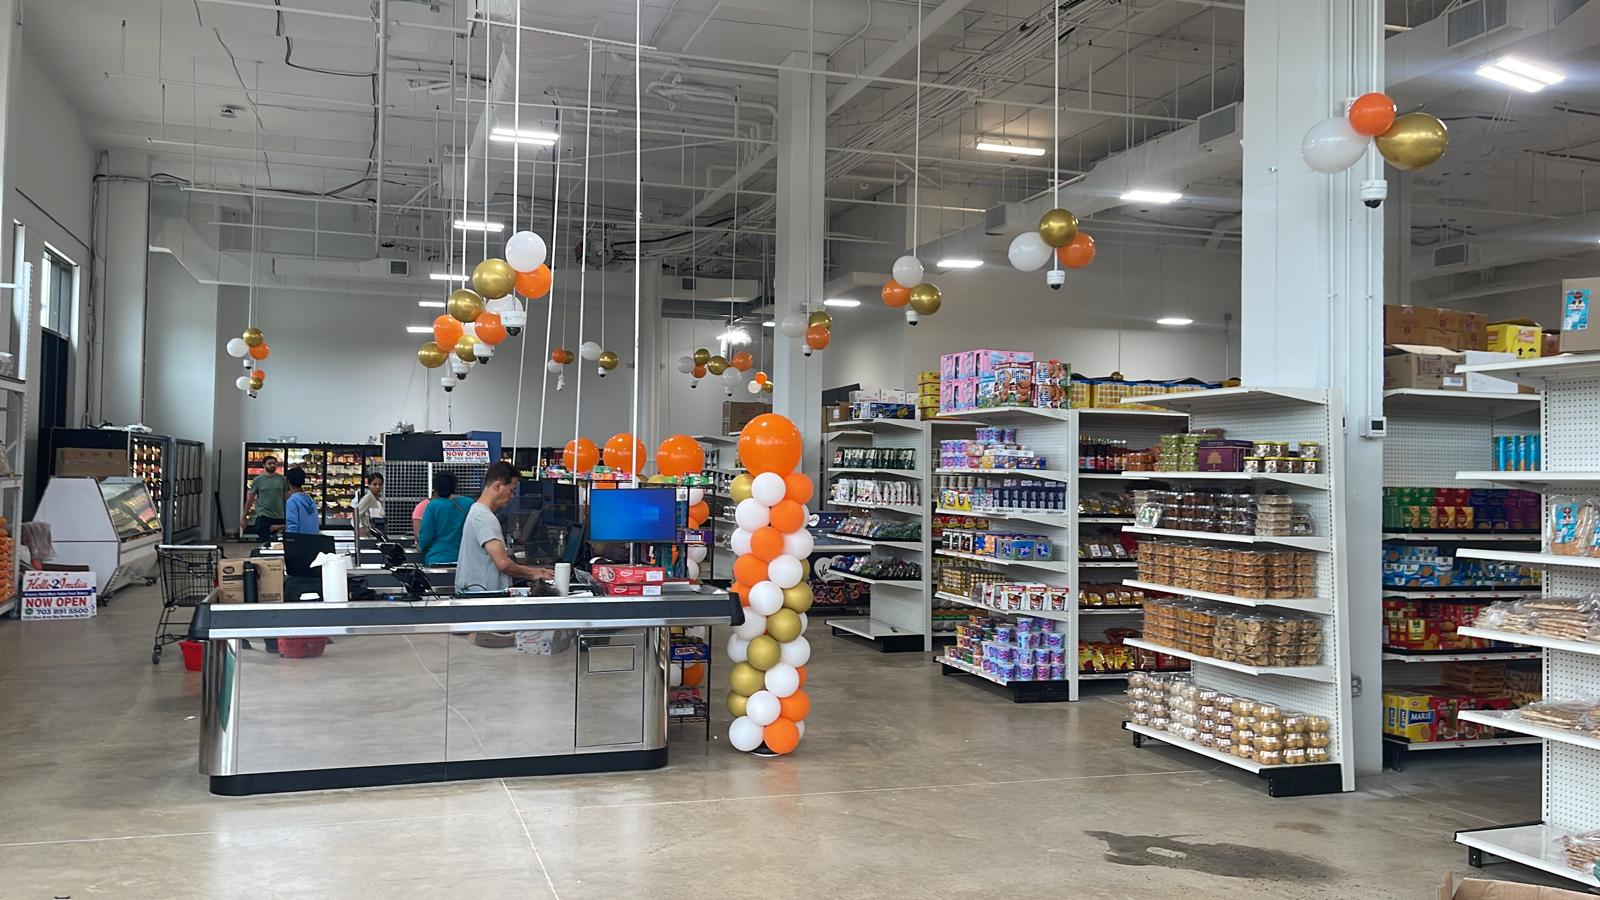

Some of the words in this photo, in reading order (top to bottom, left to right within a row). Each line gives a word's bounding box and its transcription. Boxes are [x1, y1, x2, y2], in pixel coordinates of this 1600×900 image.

[26, 598, 53, 608] NOW
[56, 597, 87, 607] OPEN
[1411, 712, 1432, 720] MARIE
